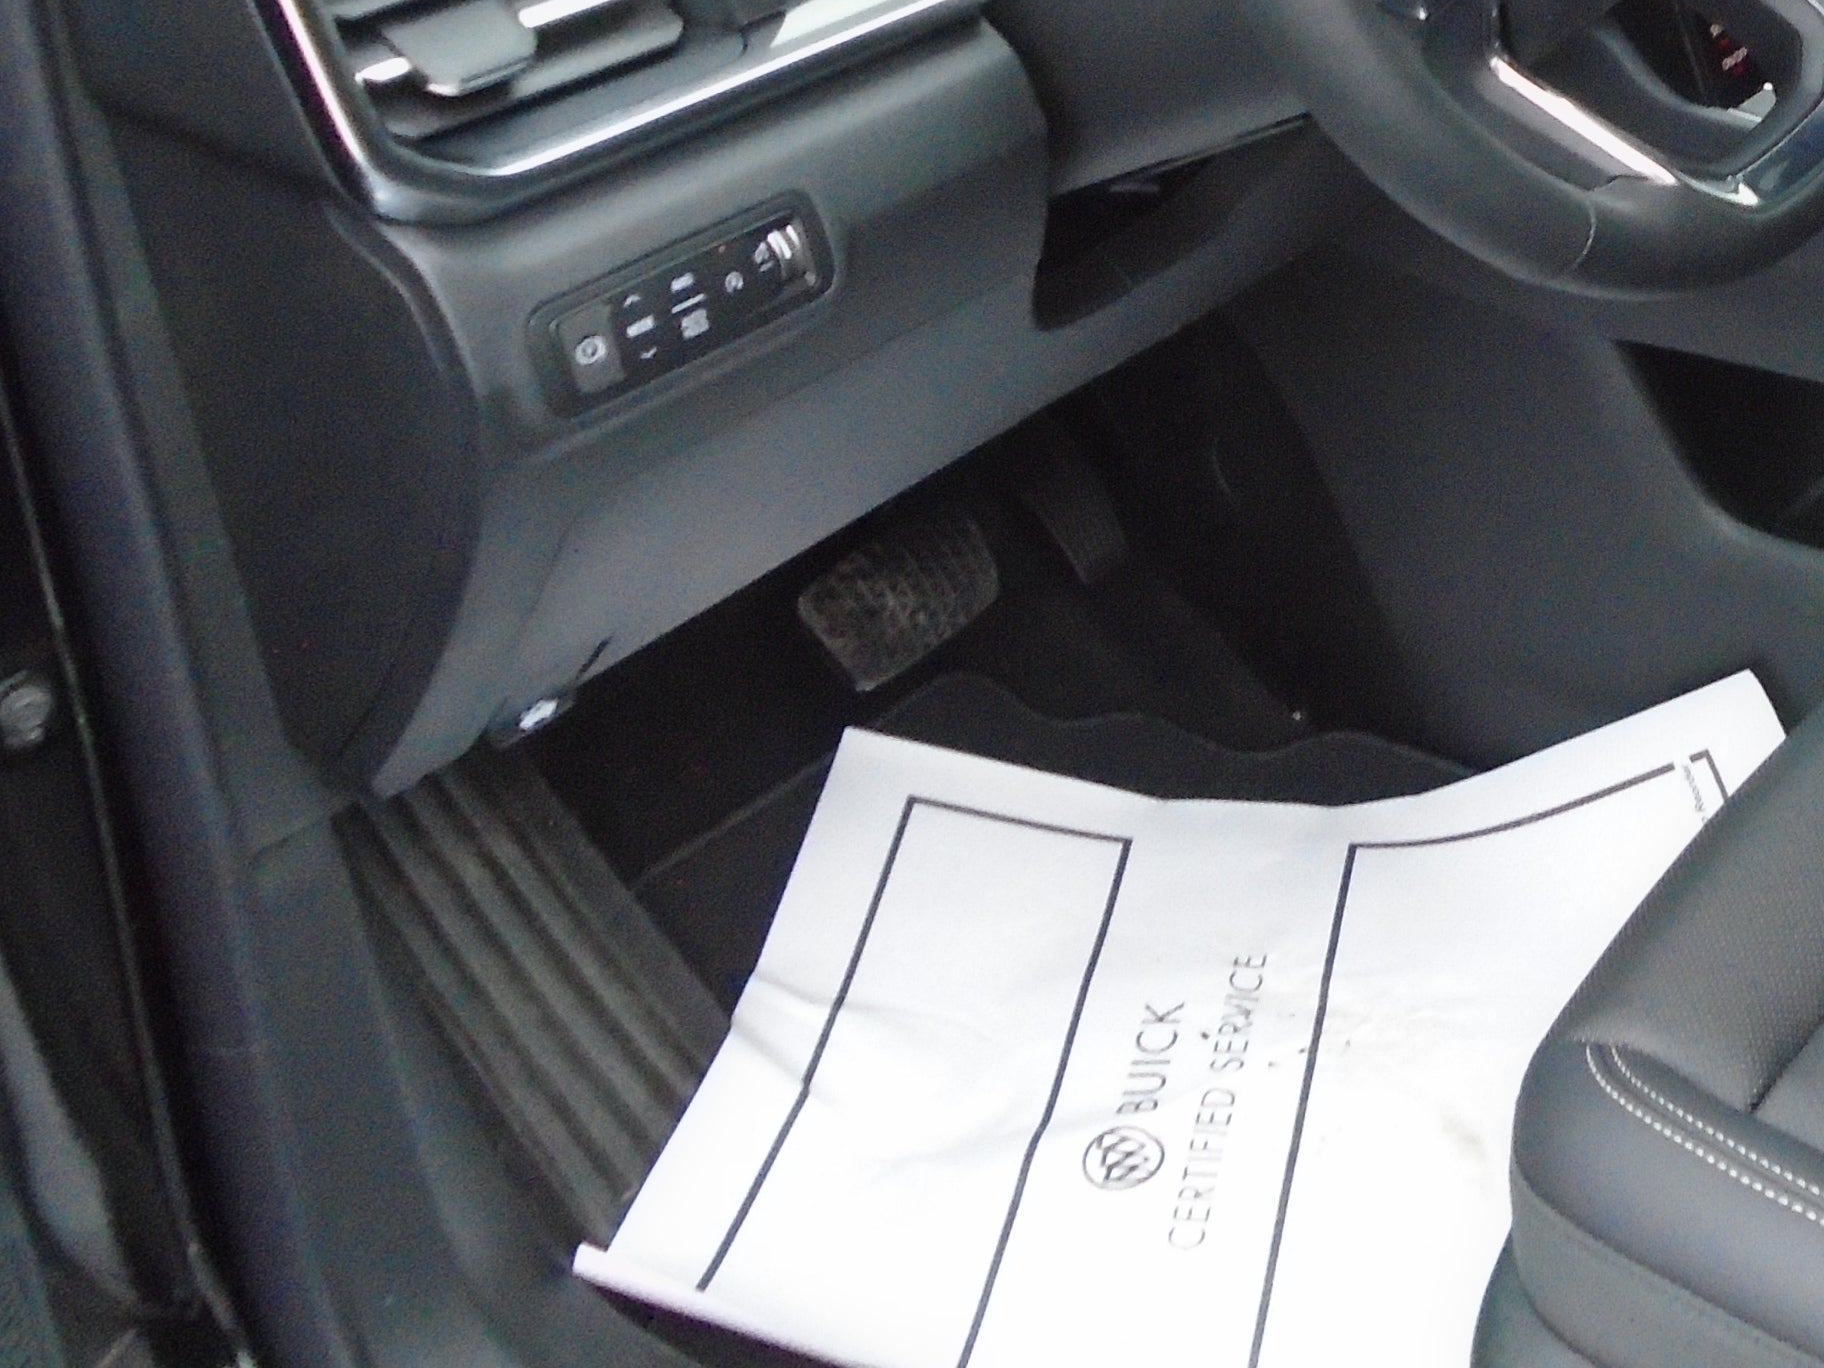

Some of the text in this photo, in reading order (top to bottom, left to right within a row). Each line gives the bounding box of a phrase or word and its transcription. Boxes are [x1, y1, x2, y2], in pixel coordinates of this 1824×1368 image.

[1115, 1000, 1186, 1116] BUICK
[1167, 953, 1268, 1252] CERTIFIED SERVICE
